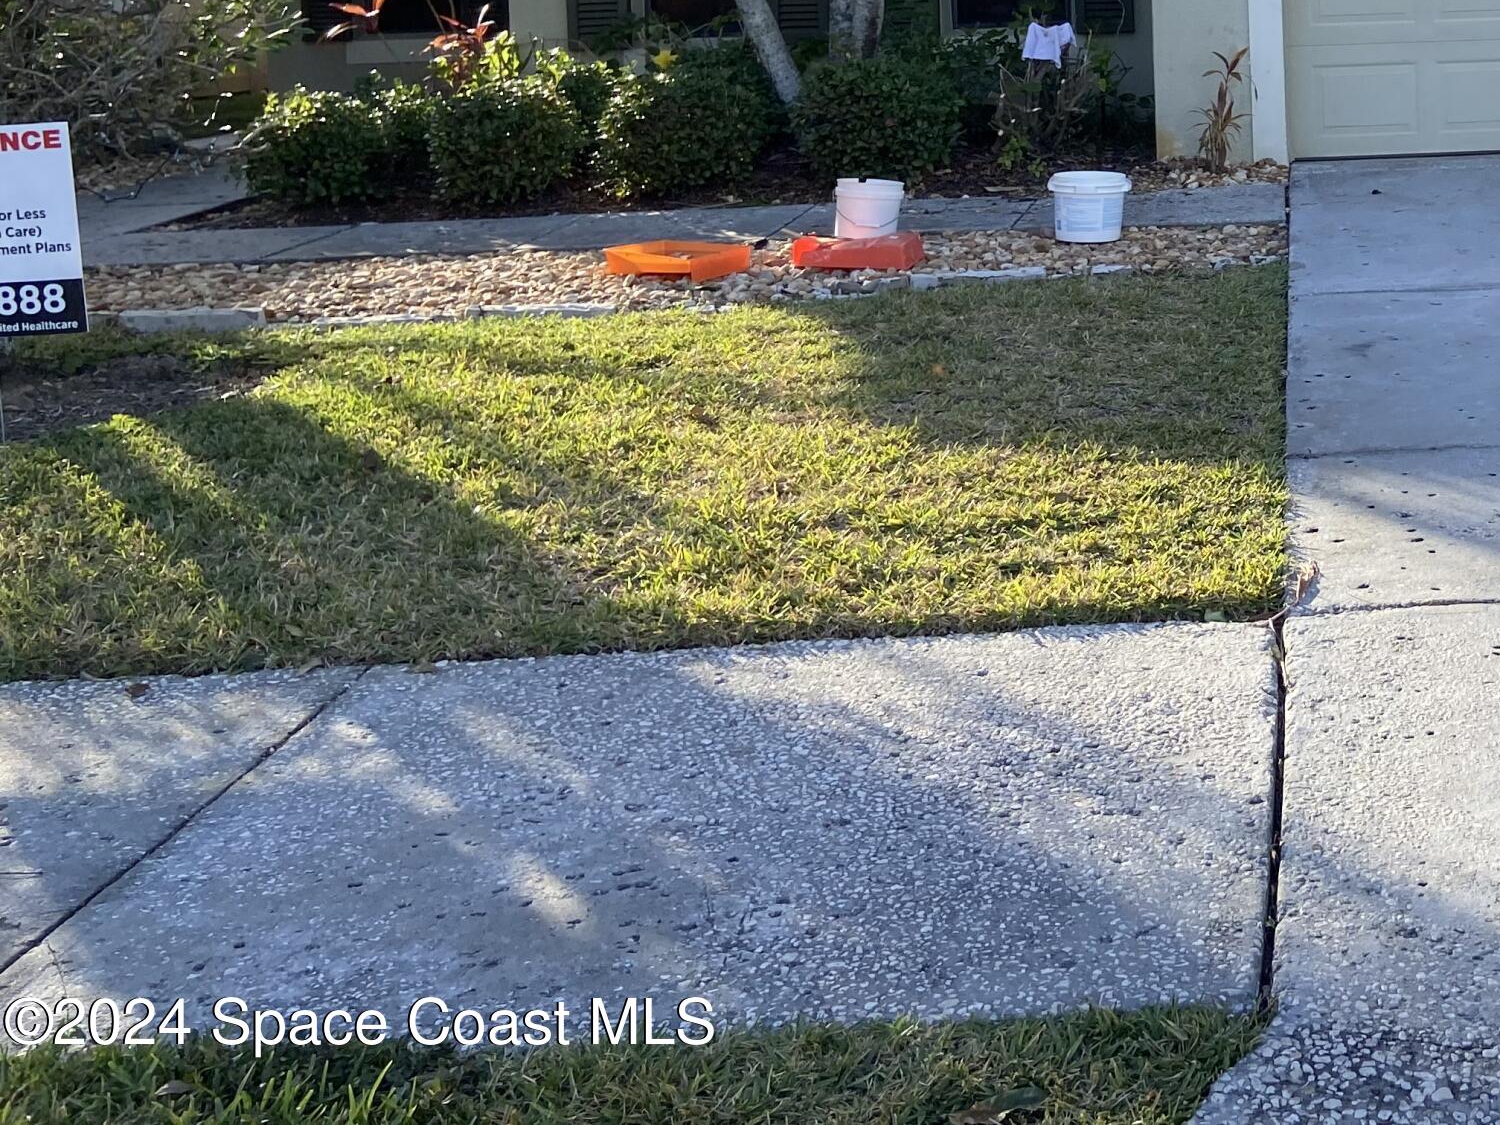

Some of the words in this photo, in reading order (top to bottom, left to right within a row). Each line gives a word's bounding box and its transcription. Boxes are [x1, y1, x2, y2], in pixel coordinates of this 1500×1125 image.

[0, 129, 62, 151] NCE
[16, 209, 46, 220] Less
[6, 226, 42, 238] Care)
[35, 242, 72, 254] Plans
[0, 283, 66, 316] 888
[21, 320, 79, 332] Healthcare
